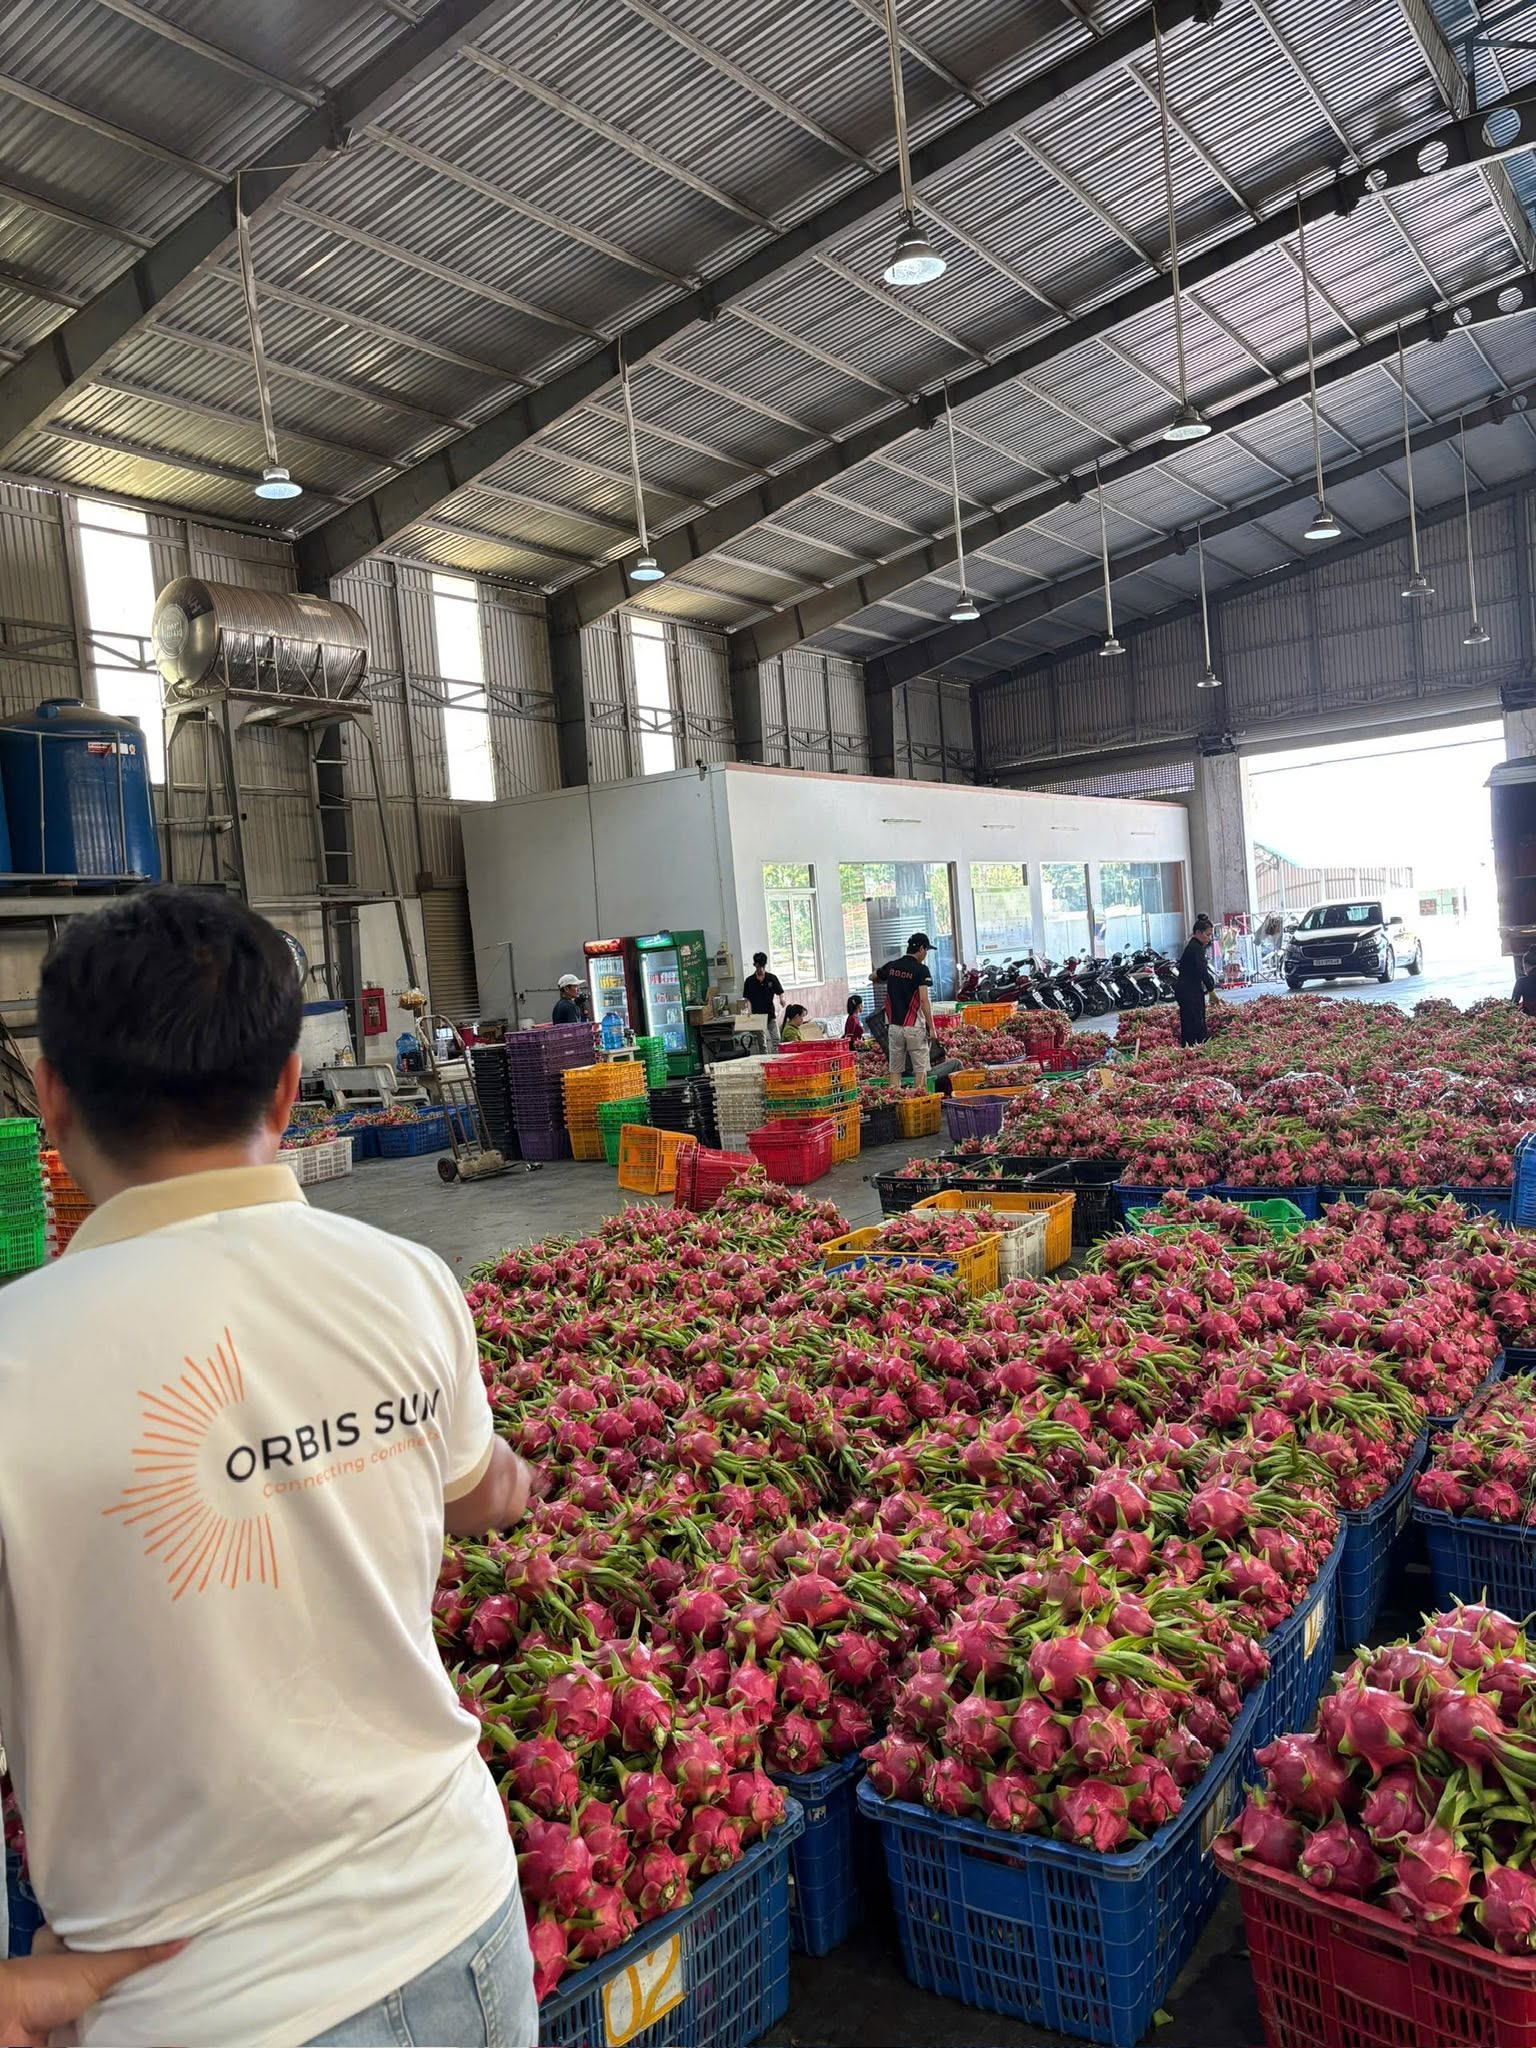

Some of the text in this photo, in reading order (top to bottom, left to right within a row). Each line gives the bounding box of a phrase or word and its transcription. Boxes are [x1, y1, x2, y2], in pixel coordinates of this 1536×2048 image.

[225, 1388, 440, 1483] ORBIS SUN
[262, 1456, 365, 1499] Connecting
